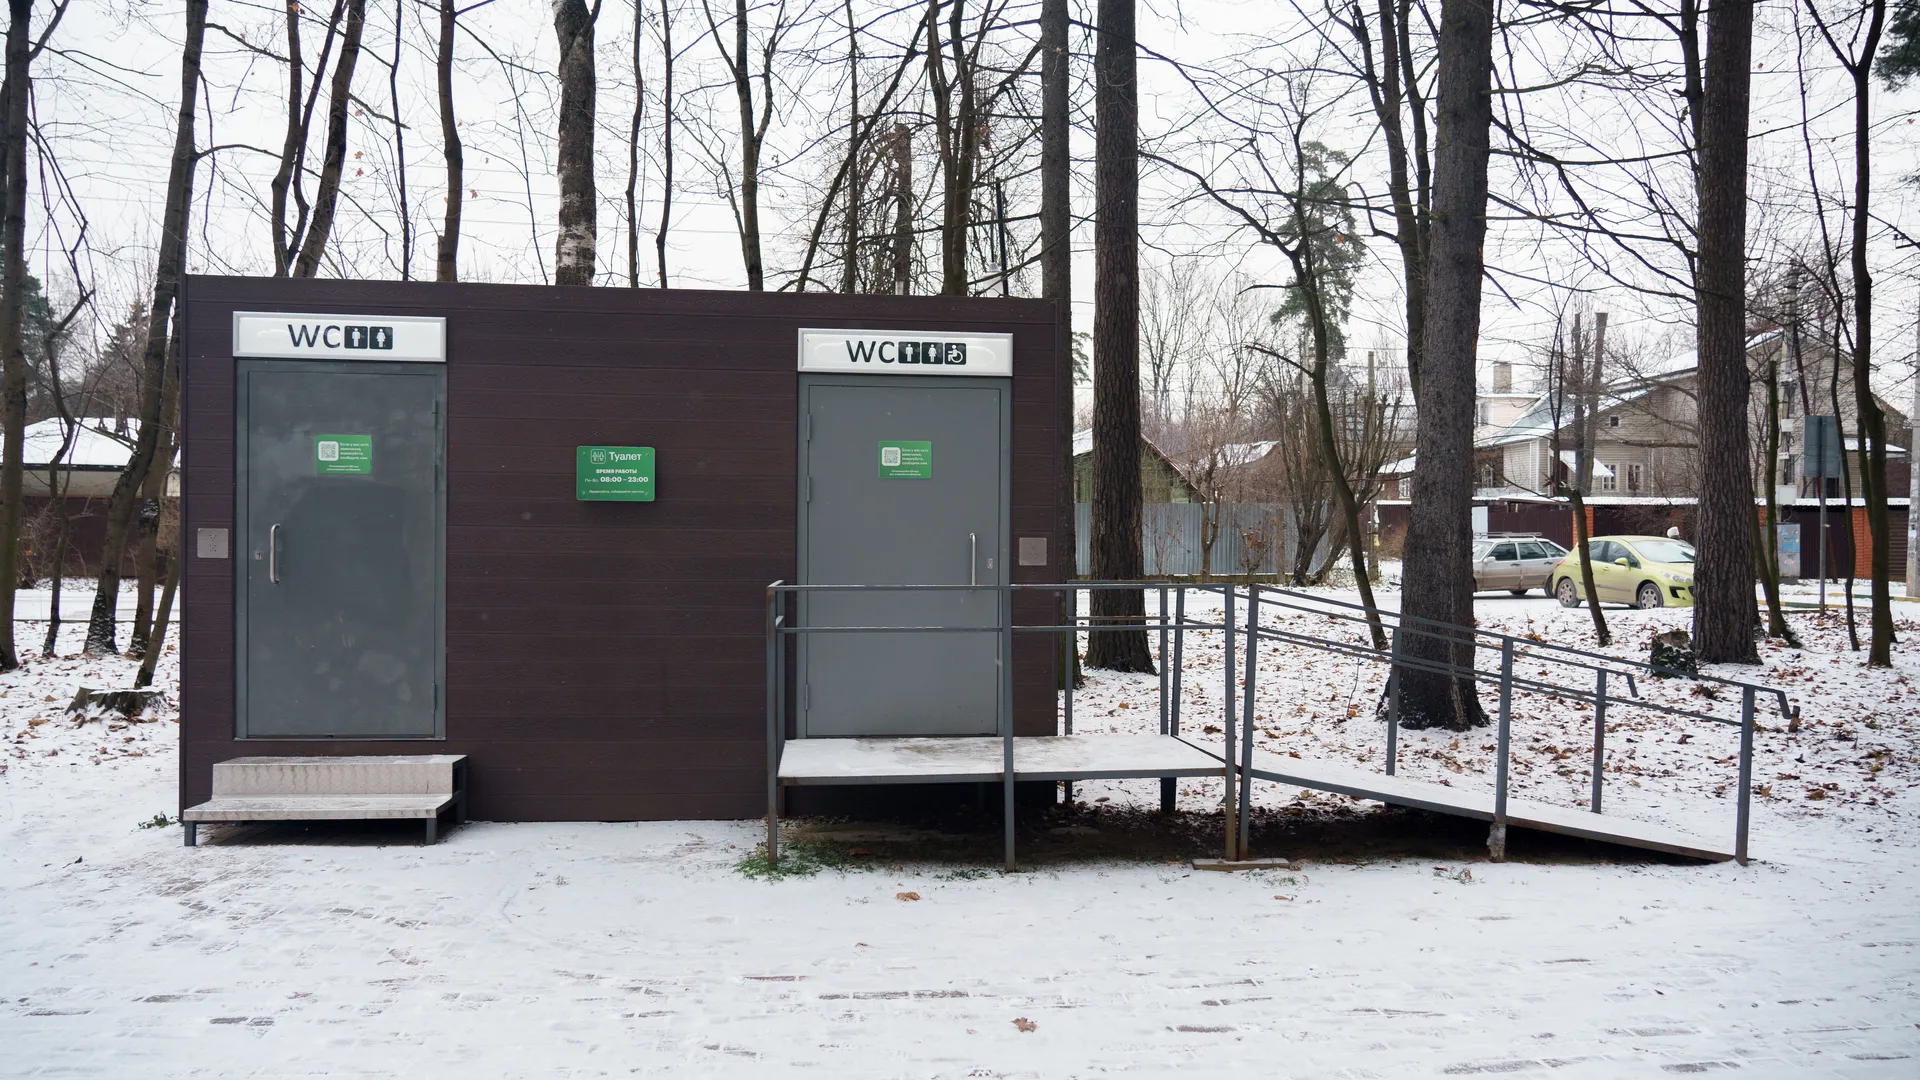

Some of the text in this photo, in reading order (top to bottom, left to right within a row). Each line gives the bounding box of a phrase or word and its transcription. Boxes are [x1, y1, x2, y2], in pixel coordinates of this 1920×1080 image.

[288, 324, 341, 348] WC
[845, 340, 895, 364] WC
[609, 451, 642, 462] Туалет
